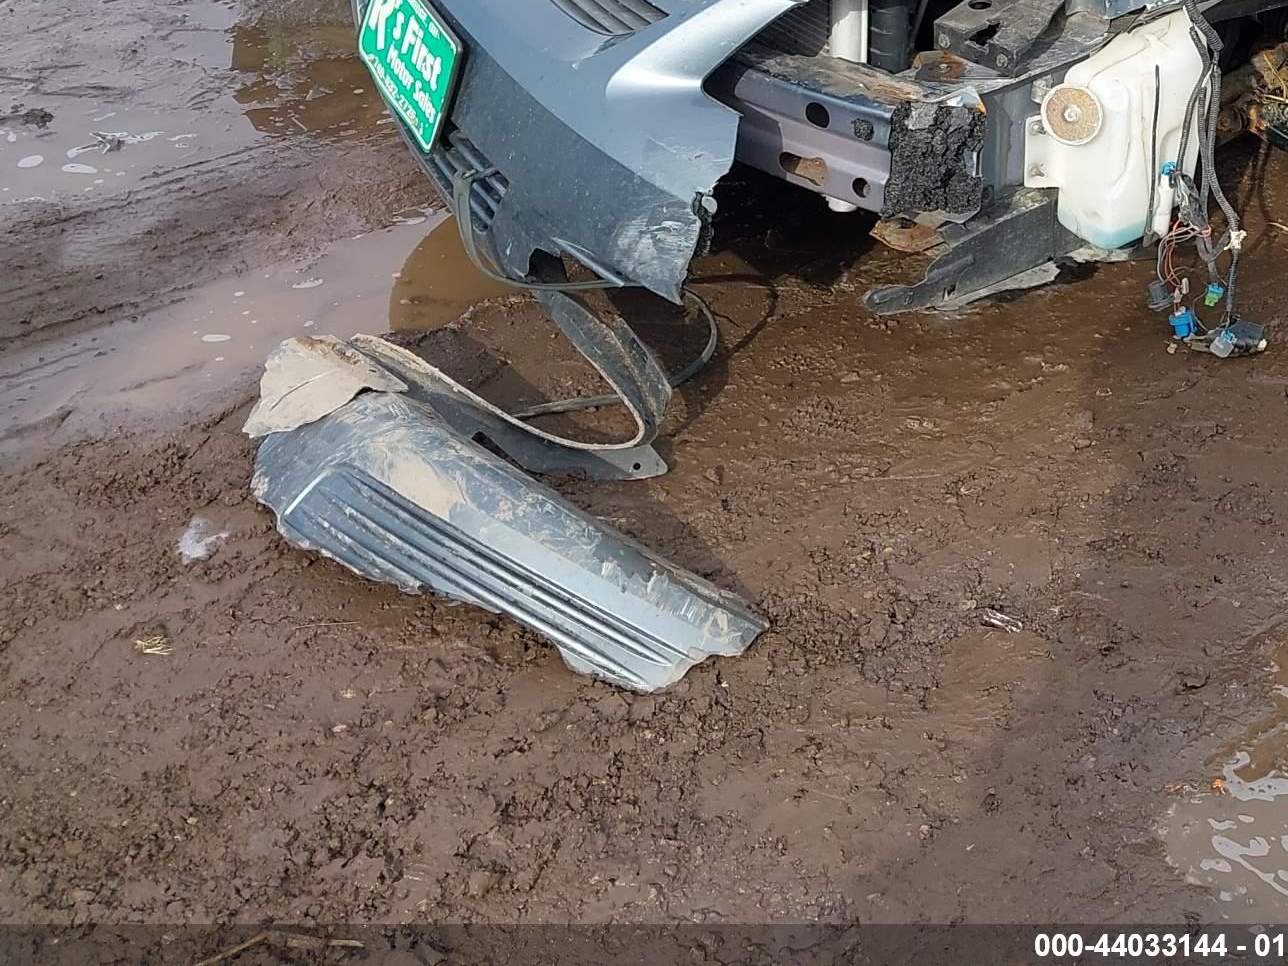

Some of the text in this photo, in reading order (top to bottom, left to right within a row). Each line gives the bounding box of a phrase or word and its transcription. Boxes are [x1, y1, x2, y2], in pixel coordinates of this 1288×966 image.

[387, 41, 436, 123] Motor Sales
[401, 15, 442, 91] First
